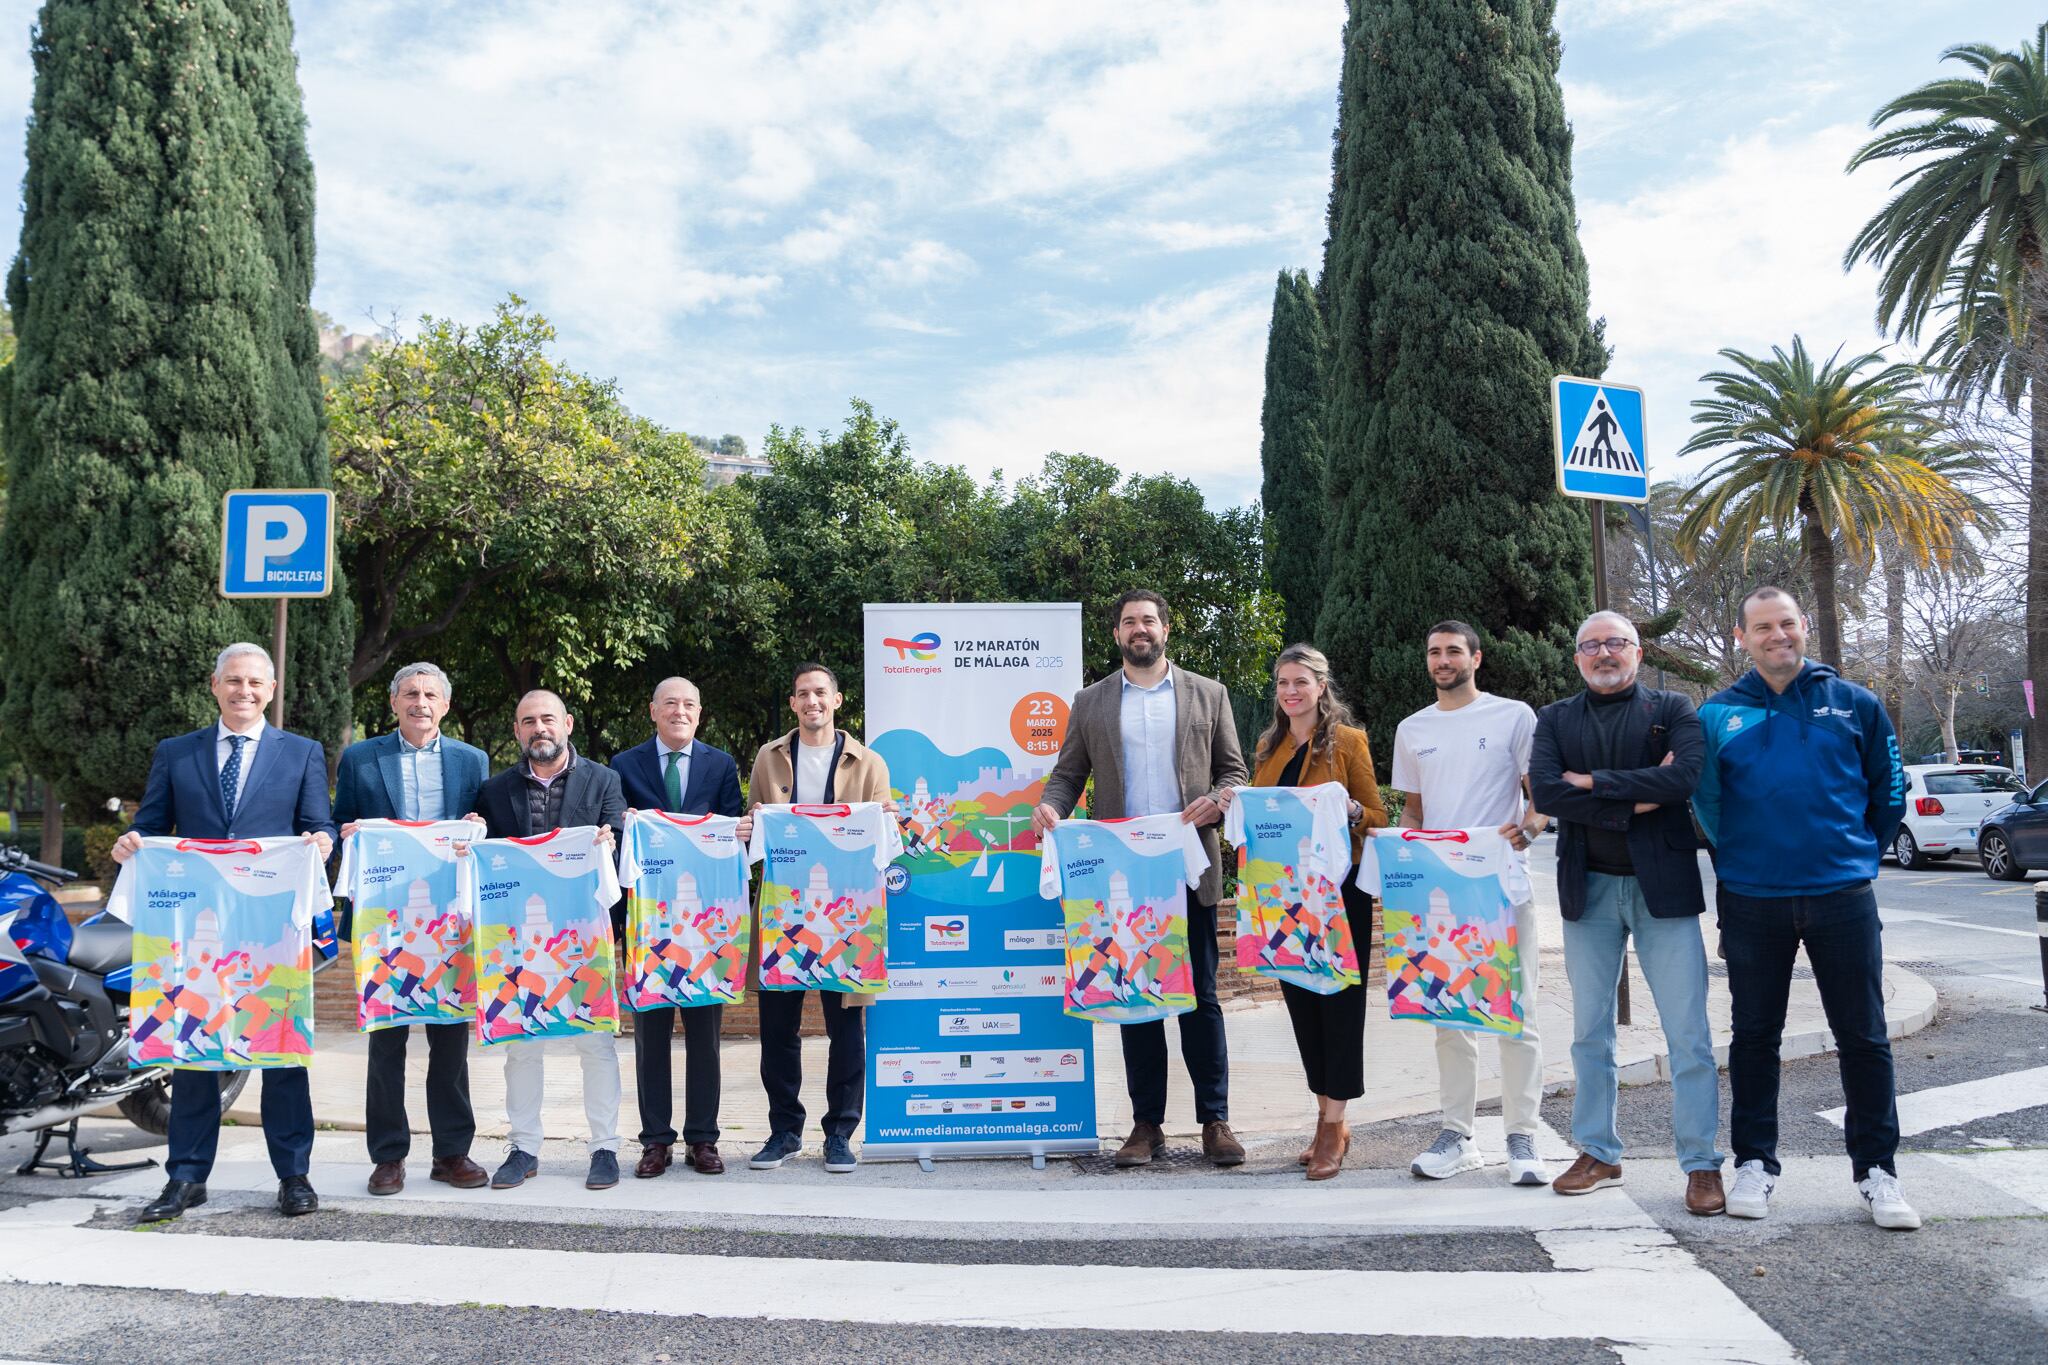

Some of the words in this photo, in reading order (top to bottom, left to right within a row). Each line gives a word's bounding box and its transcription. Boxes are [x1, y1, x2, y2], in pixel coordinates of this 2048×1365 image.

[244, 505, 307, 582] P
[266, 571, 323, 582] BICICLETAS
[954, 640, 973, 651] 1/2
[976, 638, 1040, 651] MARATÓN
[954, 657, 971, 668] DE
[974, 656, 1030, 667] MÁLAGA
[1035, 656, 1063, 668] 2025
[883, 666, 942, 675] TotalEnergies
[1029, 700, 1054, 715] 23
[1026, 718, 1057, 727] MARZO
[1031, 729, 1053, 737] 2025
[1026, 741, 1048, 751] 8:15
[1050, 740, 1059, 750] H
[1886, 734, 1904, 806] LUANVI
[1255, 822, 1292, 831] Málaga
[1257, 831, 1283, 839] 2025
[770, 847, 807, 857] Málaga
[1066, 857, 1105, 870] Málaga
[363, 865, 405, 875] Málaga
[1069, 867, 1095, 878] 2025
[363, 874, 392, 885] 2025
[1384, 871, 1425, 881] Málaga
[479, 880, 521, 892] Málaga
[1385, 881, 1414, 889] 2025
[147, 889, 197, 900] Málaga
[480, 890, 509, 901] 2025
[148, 900, 181, 908] 2025
[982, 1021, 999, 1029] UAX
[879, 1120, 1084, 1138] www.mediamaratonmalaga.com/
